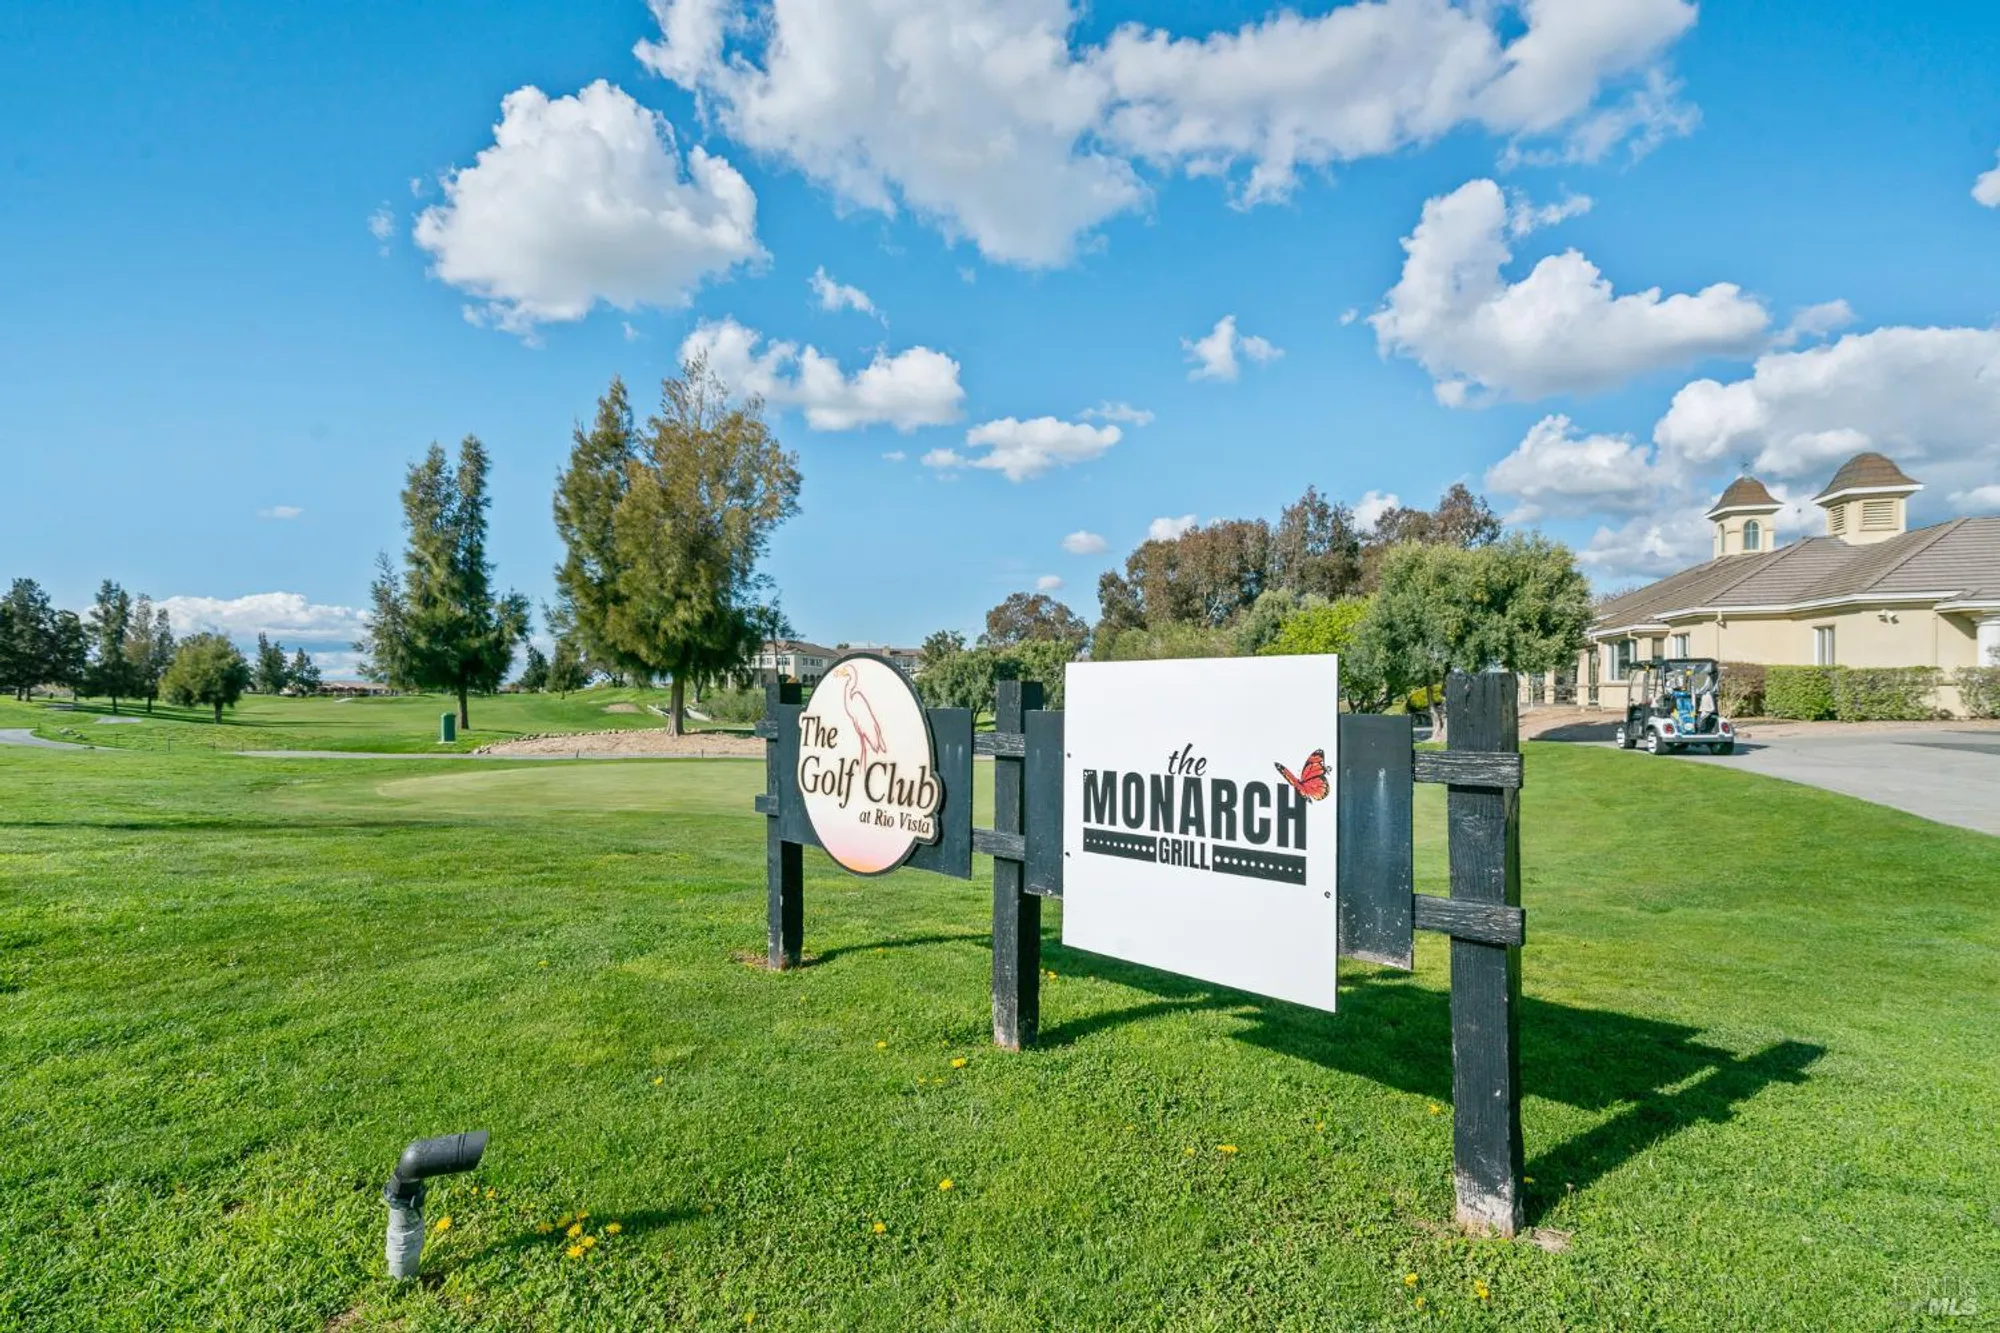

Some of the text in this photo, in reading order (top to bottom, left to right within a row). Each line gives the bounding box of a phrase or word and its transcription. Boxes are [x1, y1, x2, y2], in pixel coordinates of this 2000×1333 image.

[801, 716, 838, 749] The
[1167, 742, 1207, 776] the
[801, 756, 934, 809] Golf Club
[859, 809, 929, 833] at Rio Vista
[1083, 769, 1306, 850] MONARCH
[1158, 836, 1211, 871] GRILL
